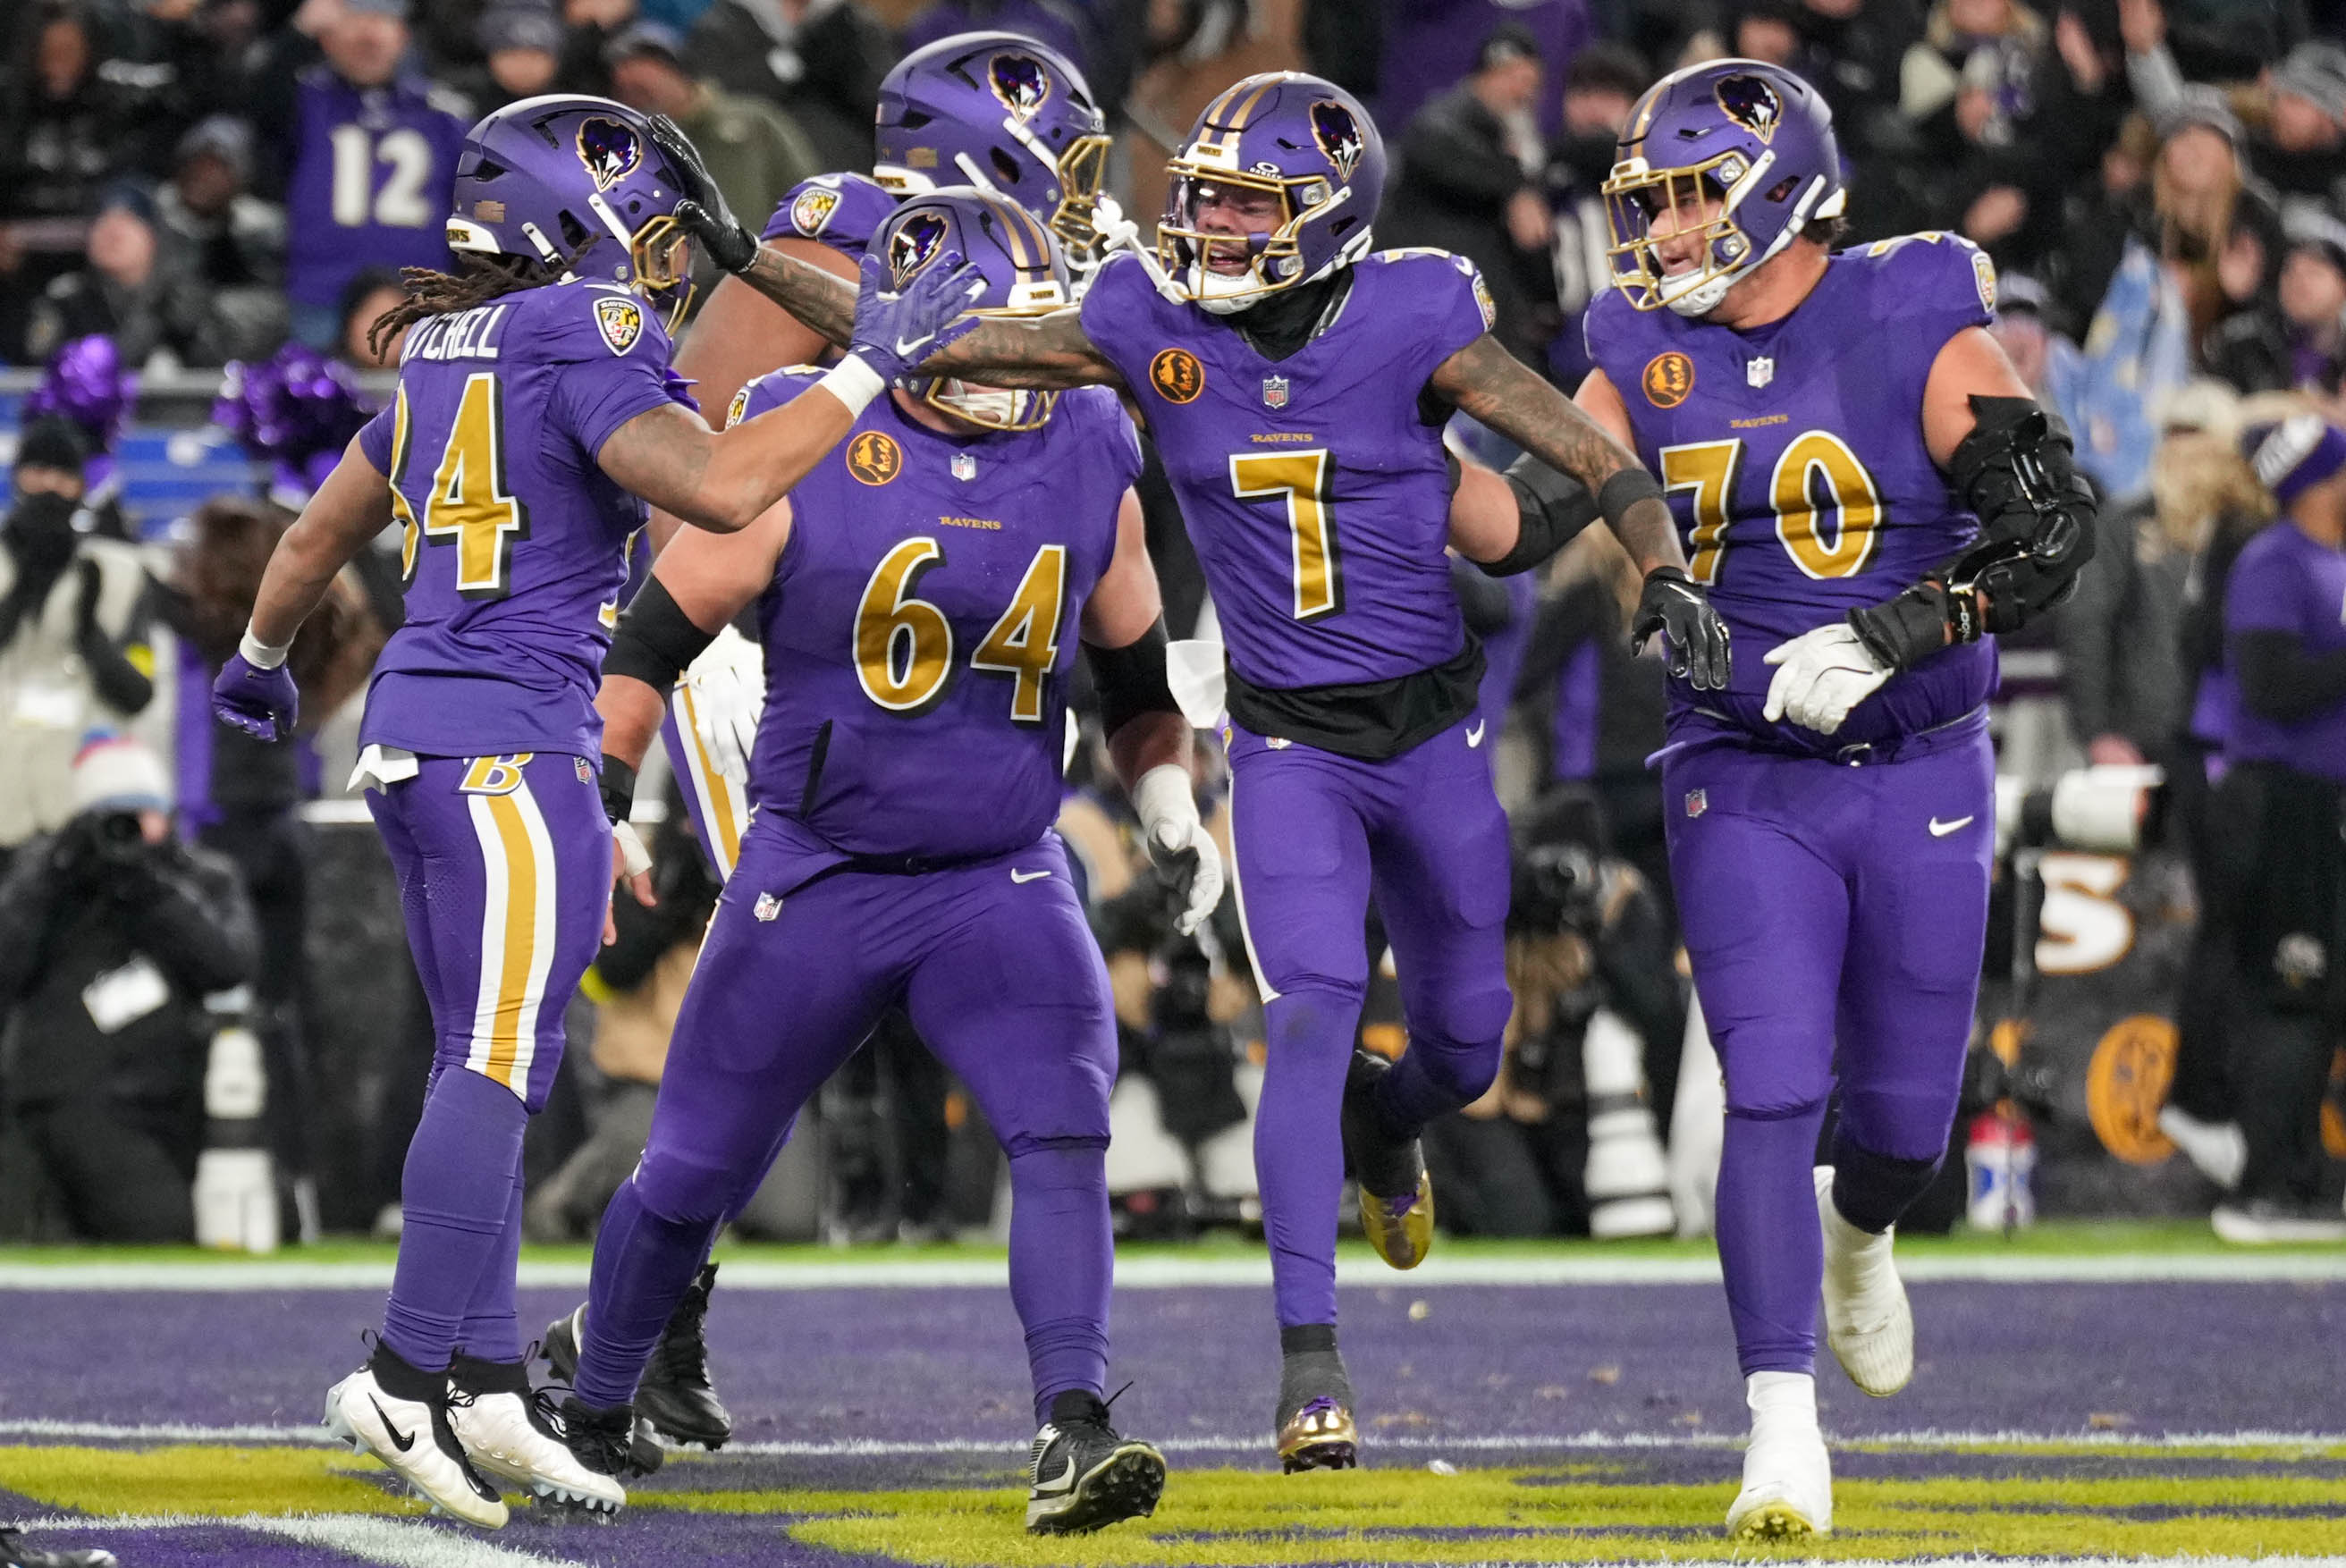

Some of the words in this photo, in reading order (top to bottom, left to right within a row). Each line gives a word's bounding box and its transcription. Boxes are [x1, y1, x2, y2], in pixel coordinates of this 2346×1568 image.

[330, 123, 433, 228] 12
[1250, 434, 1314, 443] RAVENS
[1729, 414, 1789, 429] RAVENS
[939, 517, 1002, 530] RAVENS
[1229, 449, 1336, 620] 7
[1659, 430, 1882, 586] 70
[853, 536, 1066, 721] 64
